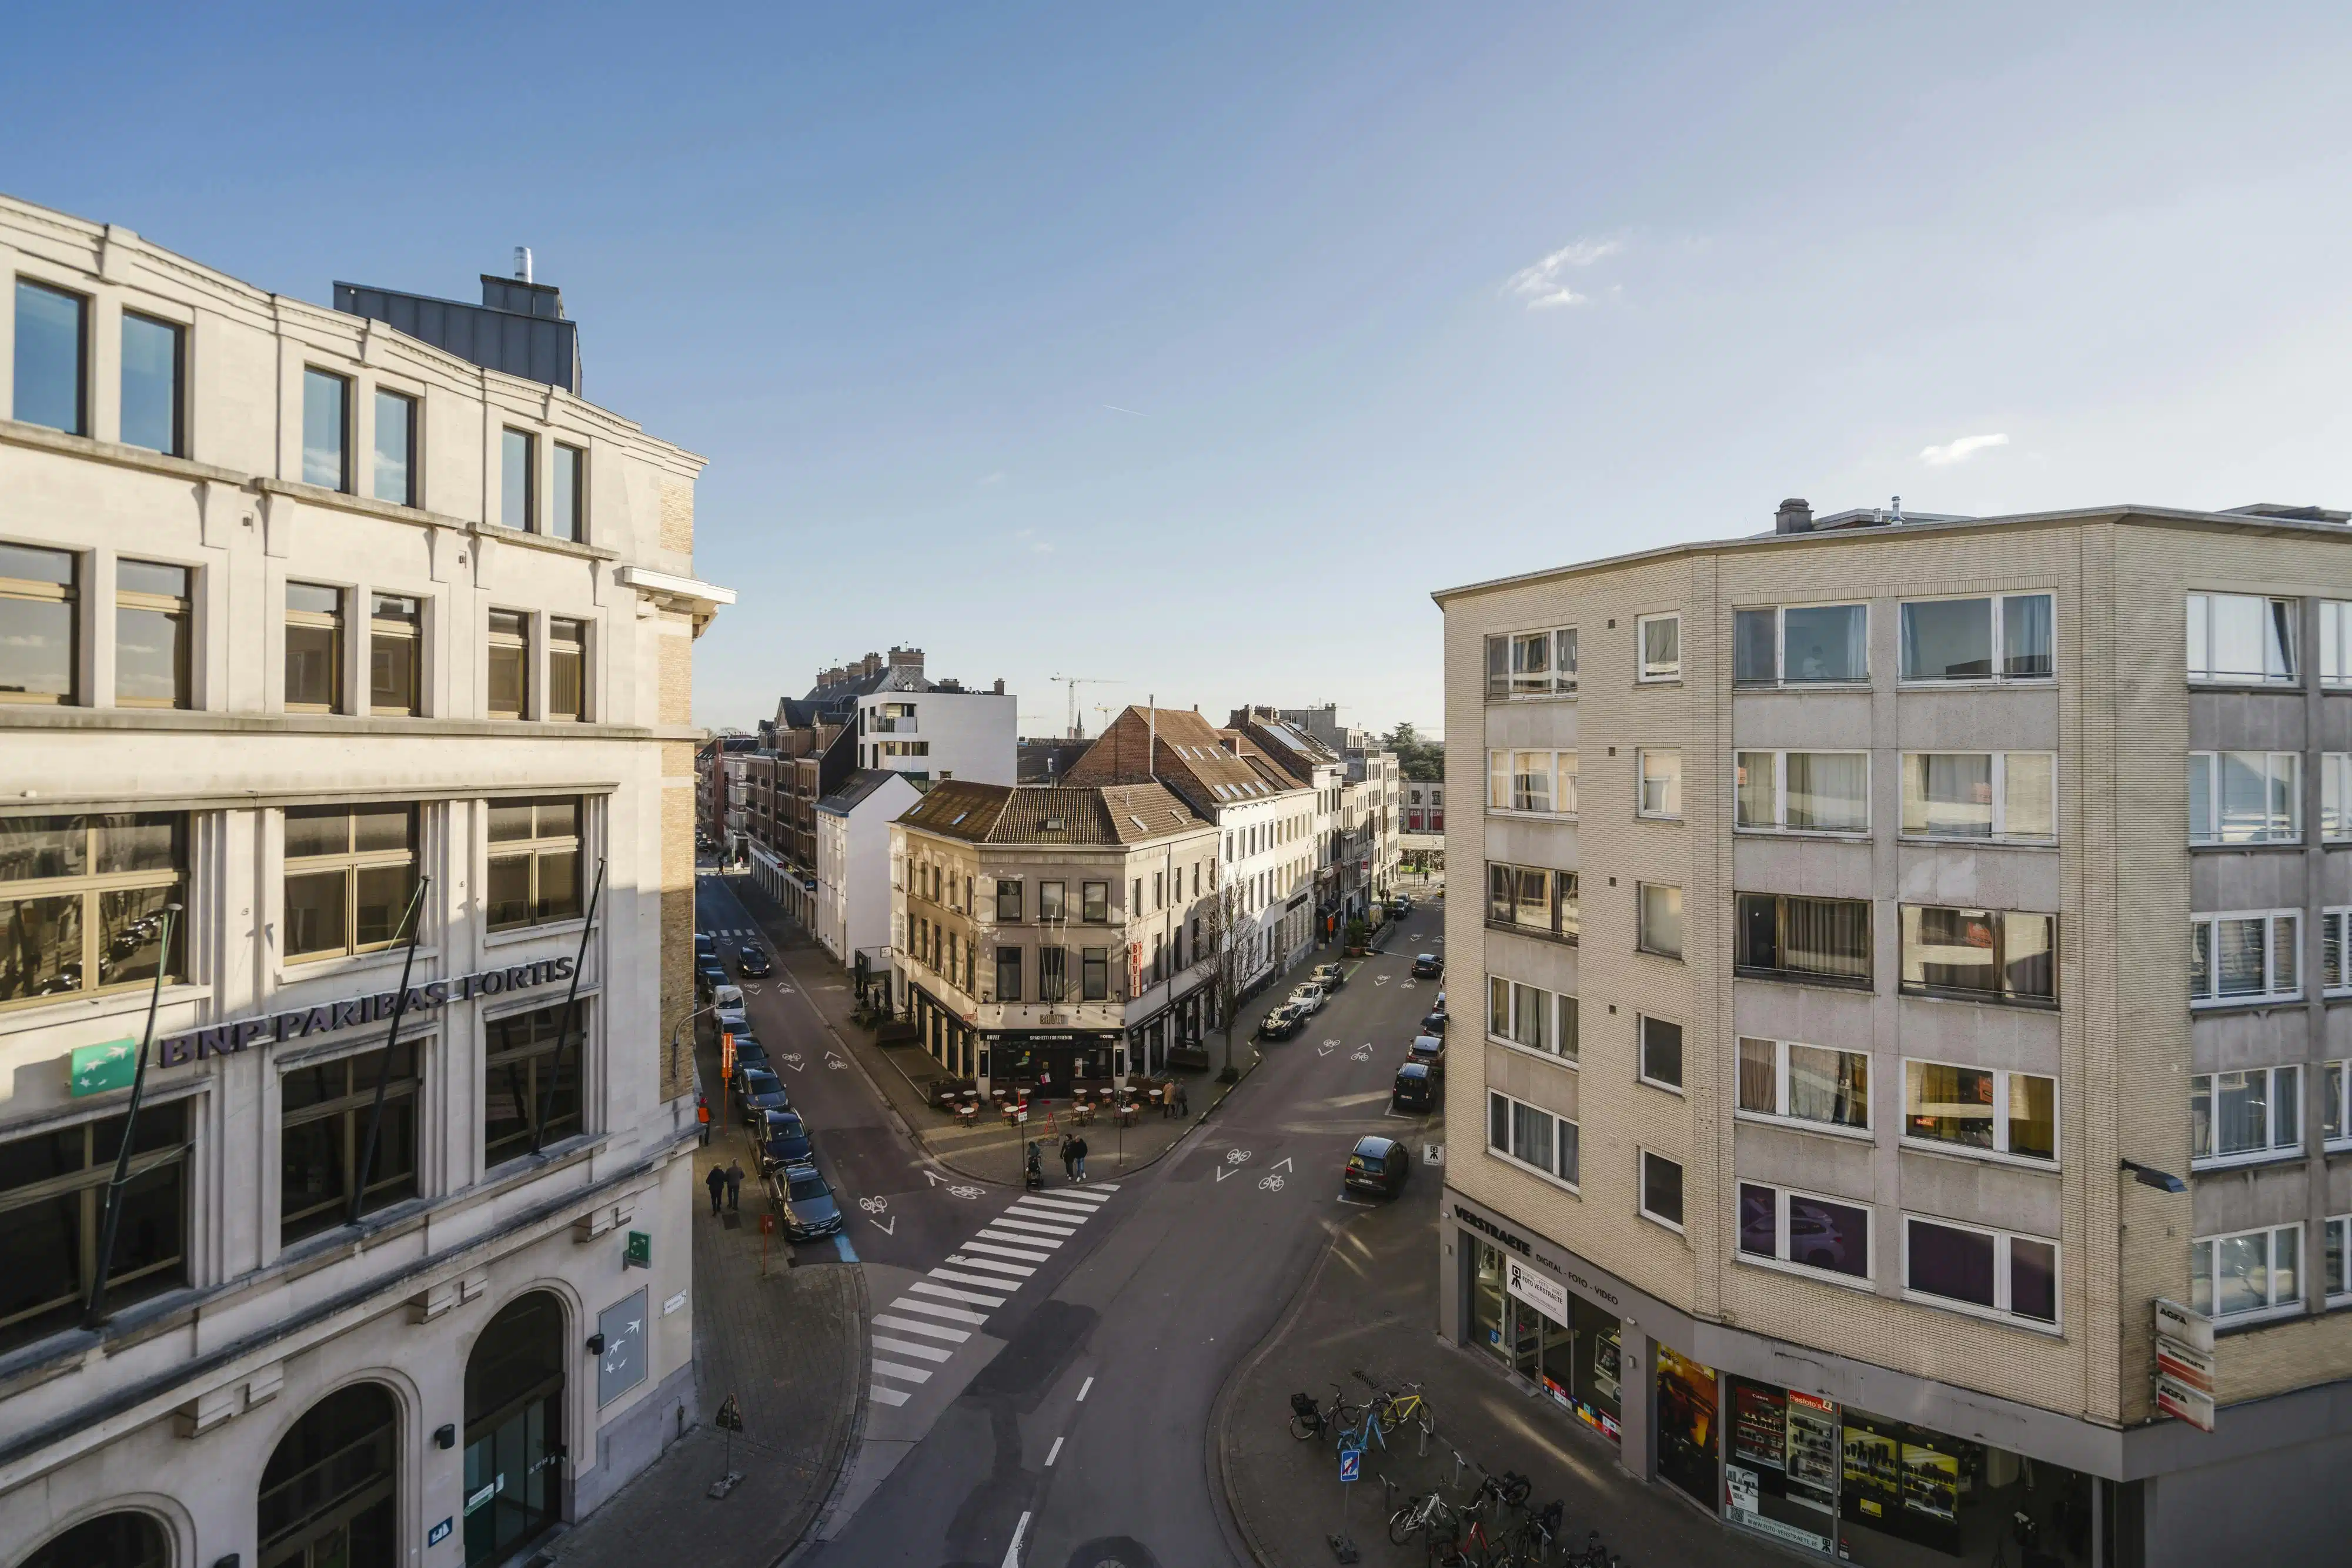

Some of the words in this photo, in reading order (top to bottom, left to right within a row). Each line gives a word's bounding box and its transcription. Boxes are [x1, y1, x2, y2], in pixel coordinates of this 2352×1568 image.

[160, 1021, 265, 1068] BNP
[276, 982, 447, 1042] PARIBAS
[463, 956, 574, 1001] FORTIS
[1040, 1014, 1064, 1025] BAVET
[1454, 1204, 1531, 1257] VERSTRAETE
[1536, 1253, 1562, 1275] DIGITAL
[1568, 1272, 1588, 1288] FOTO
[1594, 1285, 1618, 1305] VIDEO
[1522, 1276, 1533, 1286] FOTO
[1534, 1283, 1562, 1305] VERSTRAETE
[2160, 1308, 2187, 1325] AGFA
[2168, 1350, 2206, 1371] VERSTRAETE
[1790, 1394, 1822, 1409] Pasfoto's
[2160, 1385, 2187, 1403] AGFA
